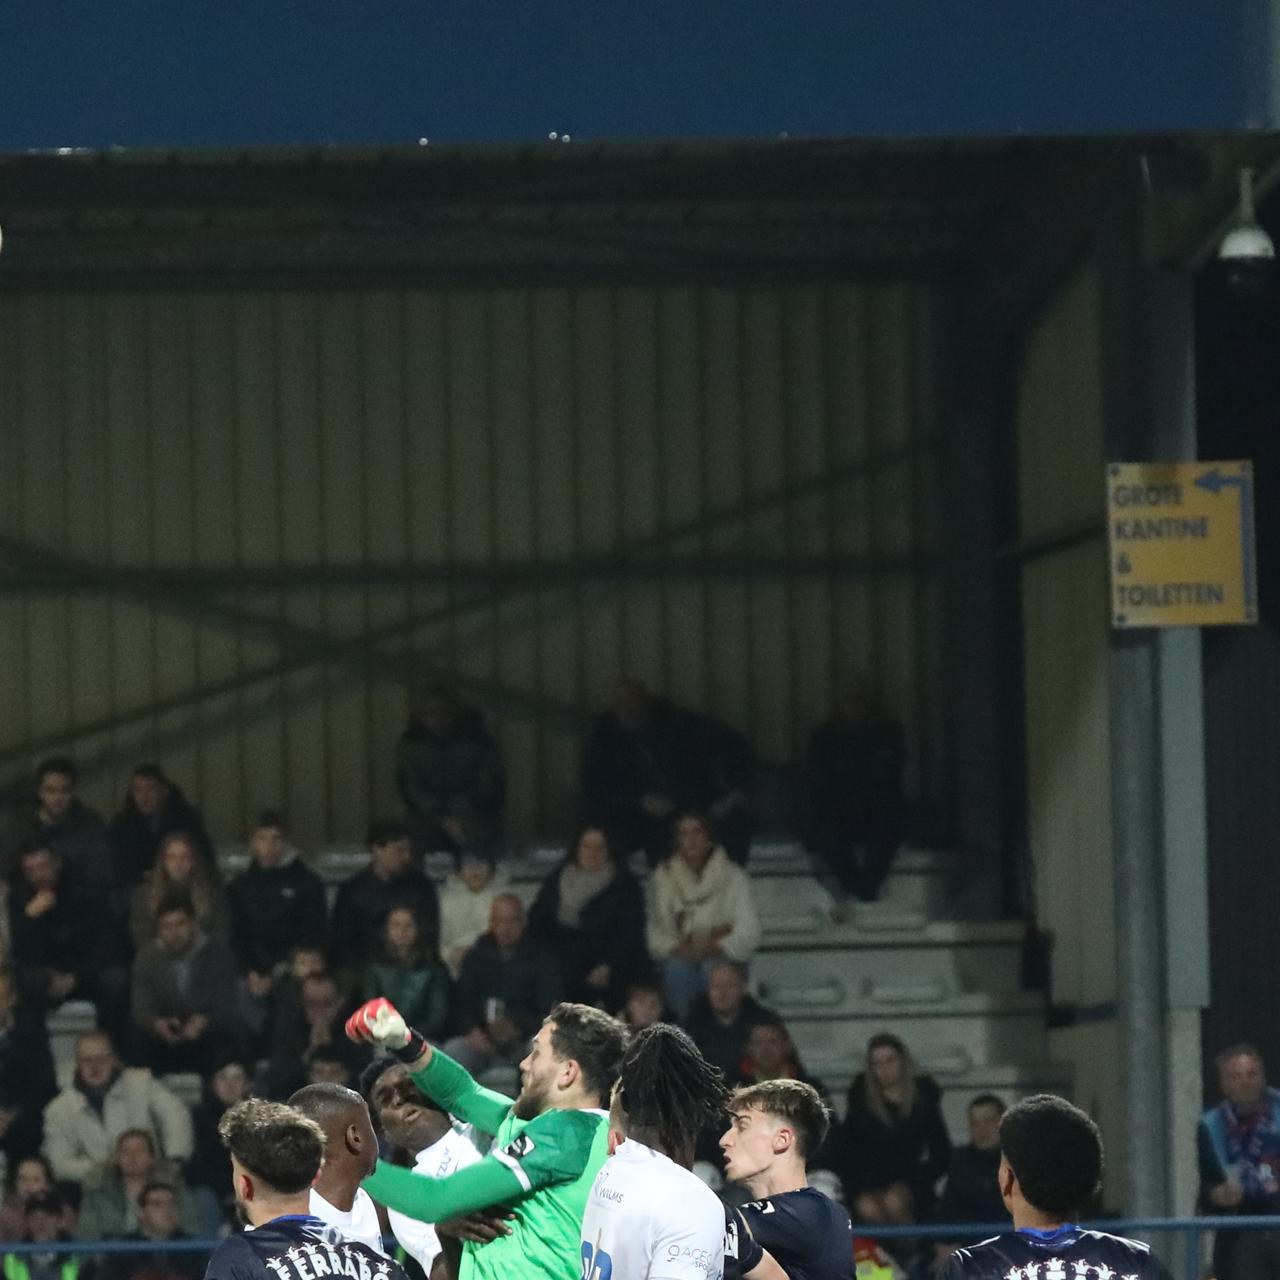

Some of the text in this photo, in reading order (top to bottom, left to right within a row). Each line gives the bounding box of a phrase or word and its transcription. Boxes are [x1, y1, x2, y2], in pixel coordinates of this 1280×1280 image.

[1114, 484, 1183, 507] GROTE
[1115, 517, 1209, 541] KANTINE
[1116, 582, 1224, 606] TOILETTEN
